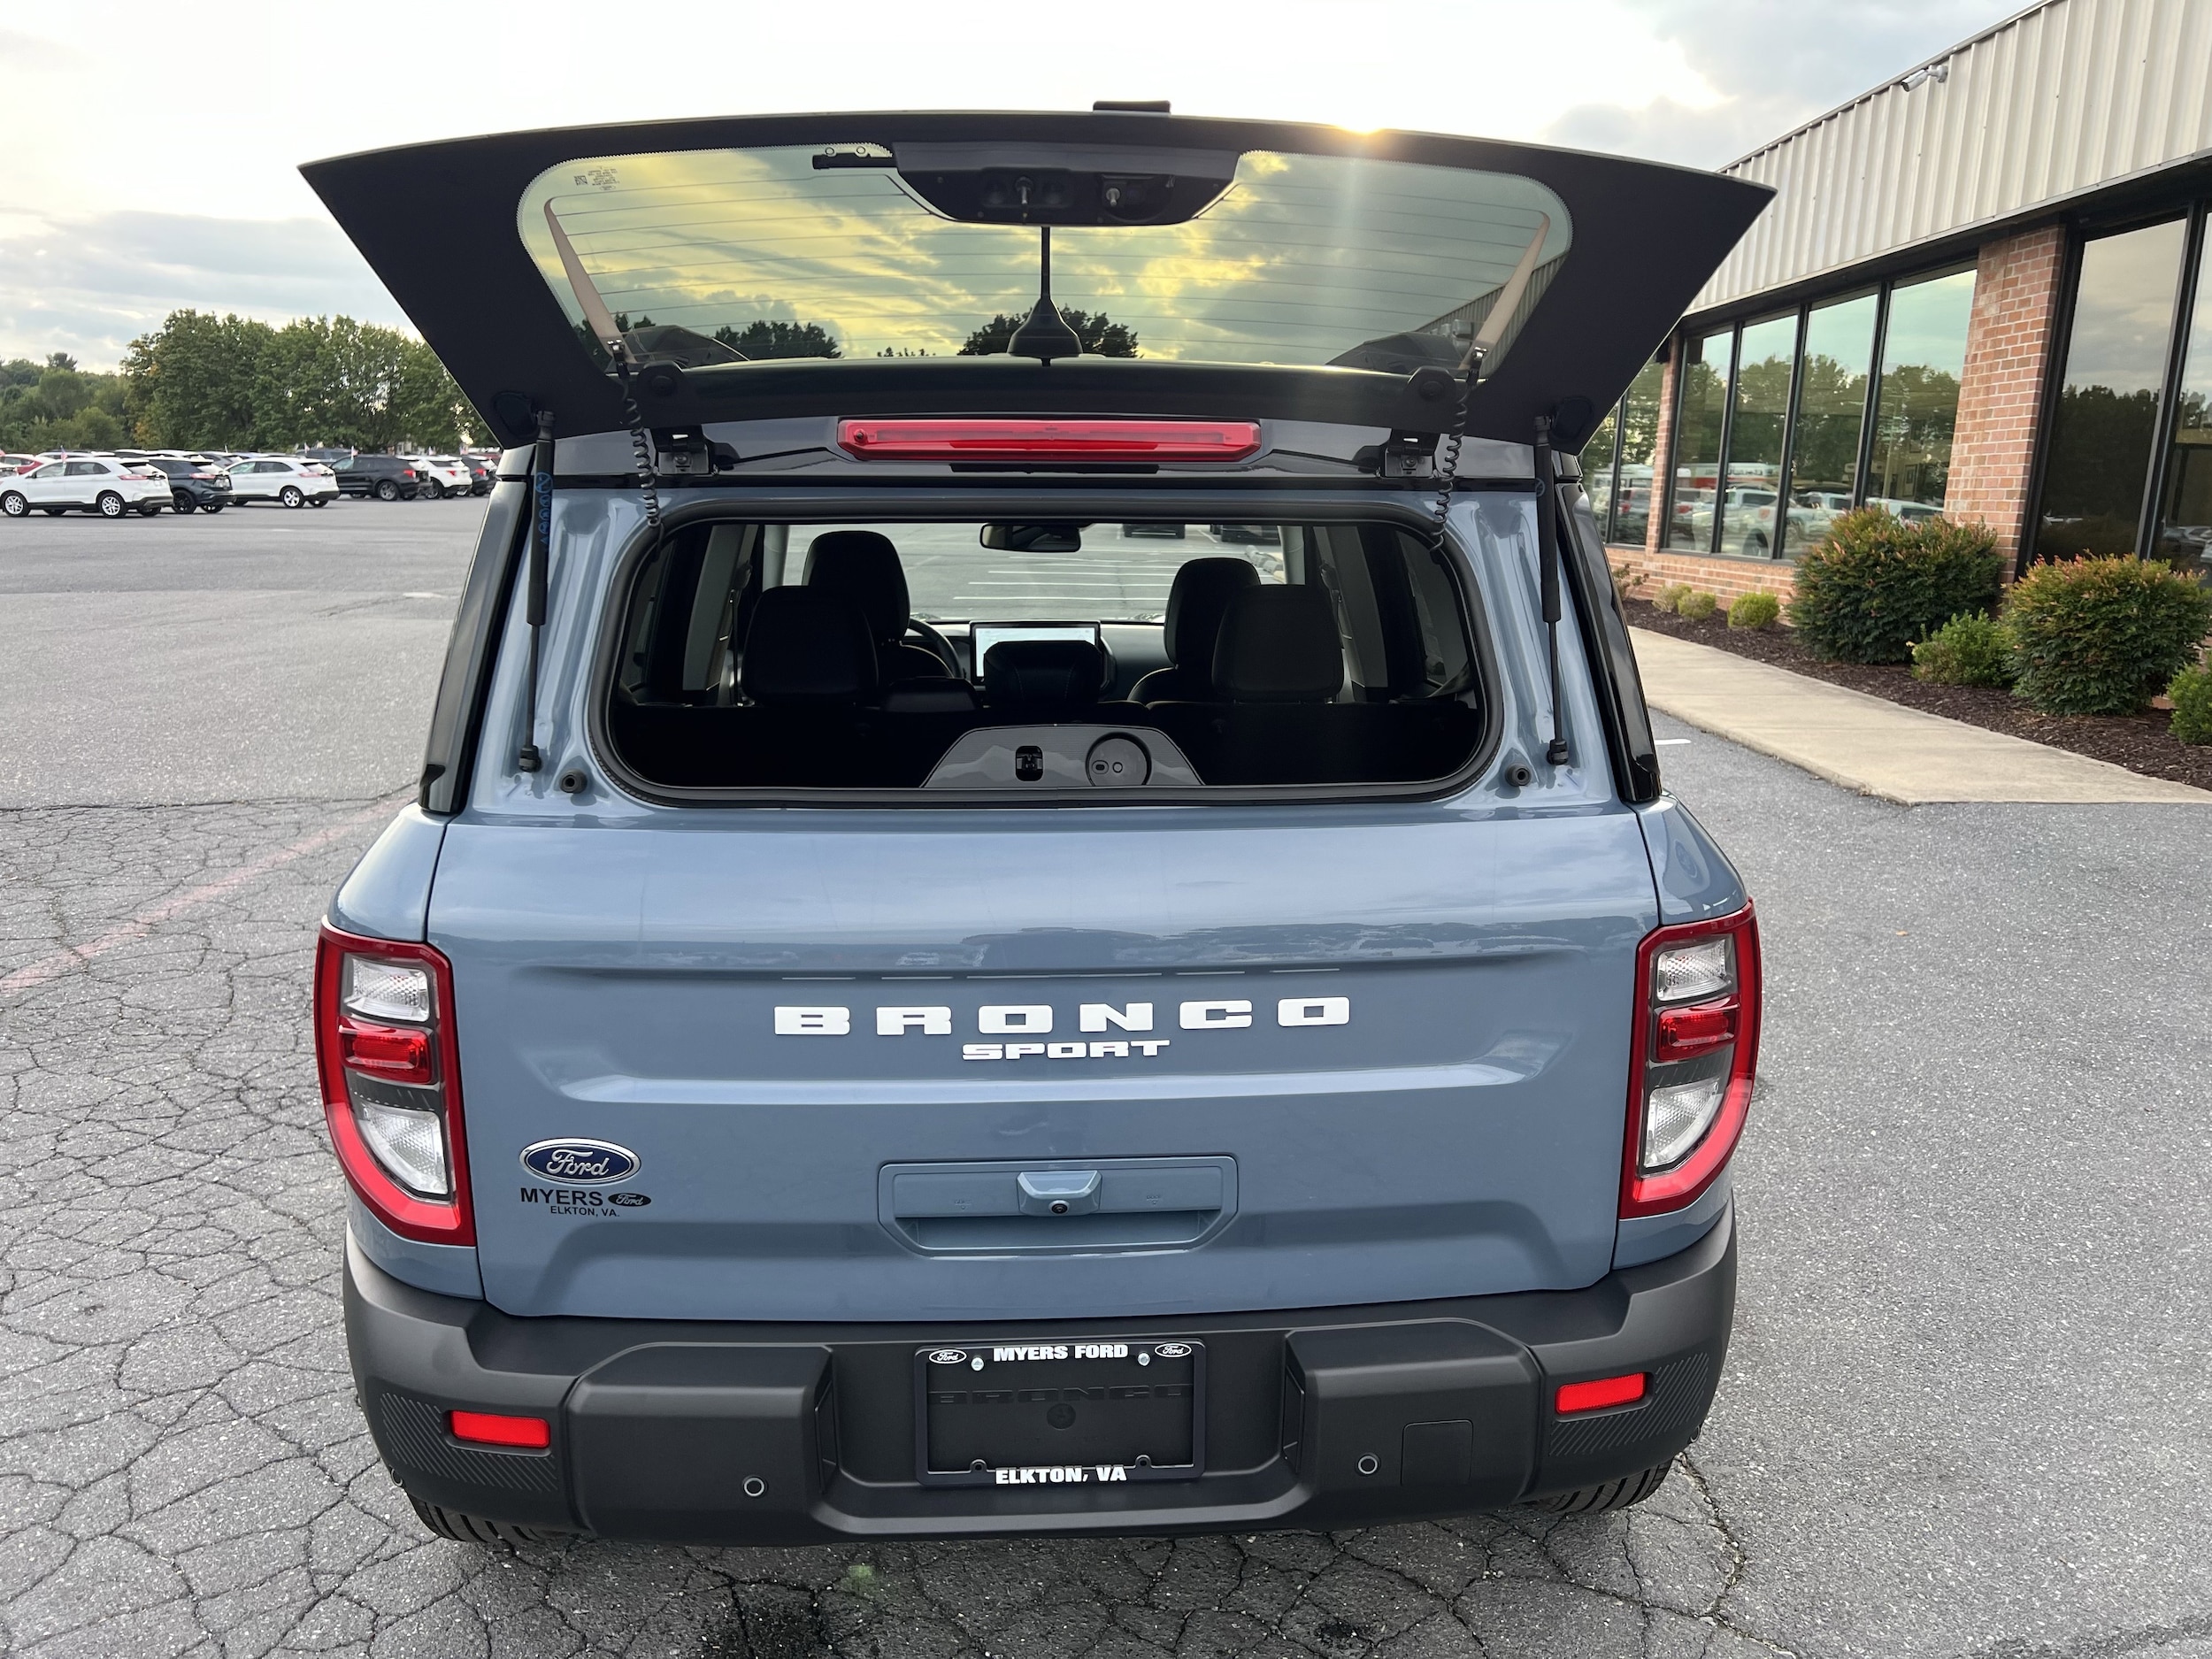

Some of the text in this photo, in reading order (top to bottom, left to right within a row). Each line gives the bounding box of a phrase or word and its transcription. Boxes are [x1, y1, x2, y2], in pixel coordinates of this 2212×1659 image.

[773, 995, 1351, 1036] BRONCO
[961, 1038, 1171, 1061] SPORT
[545, 1148, 611, 1177] Ford
[520, 1187, 644, 1206] MYERS Ford
[550, 1206, 620, 1217] ELKTON, VA.
[936, 1344, 1184, 1362] Ford MYERS FORD Ford
[995, 1464, 1127, 1485] ELKTON, VA
